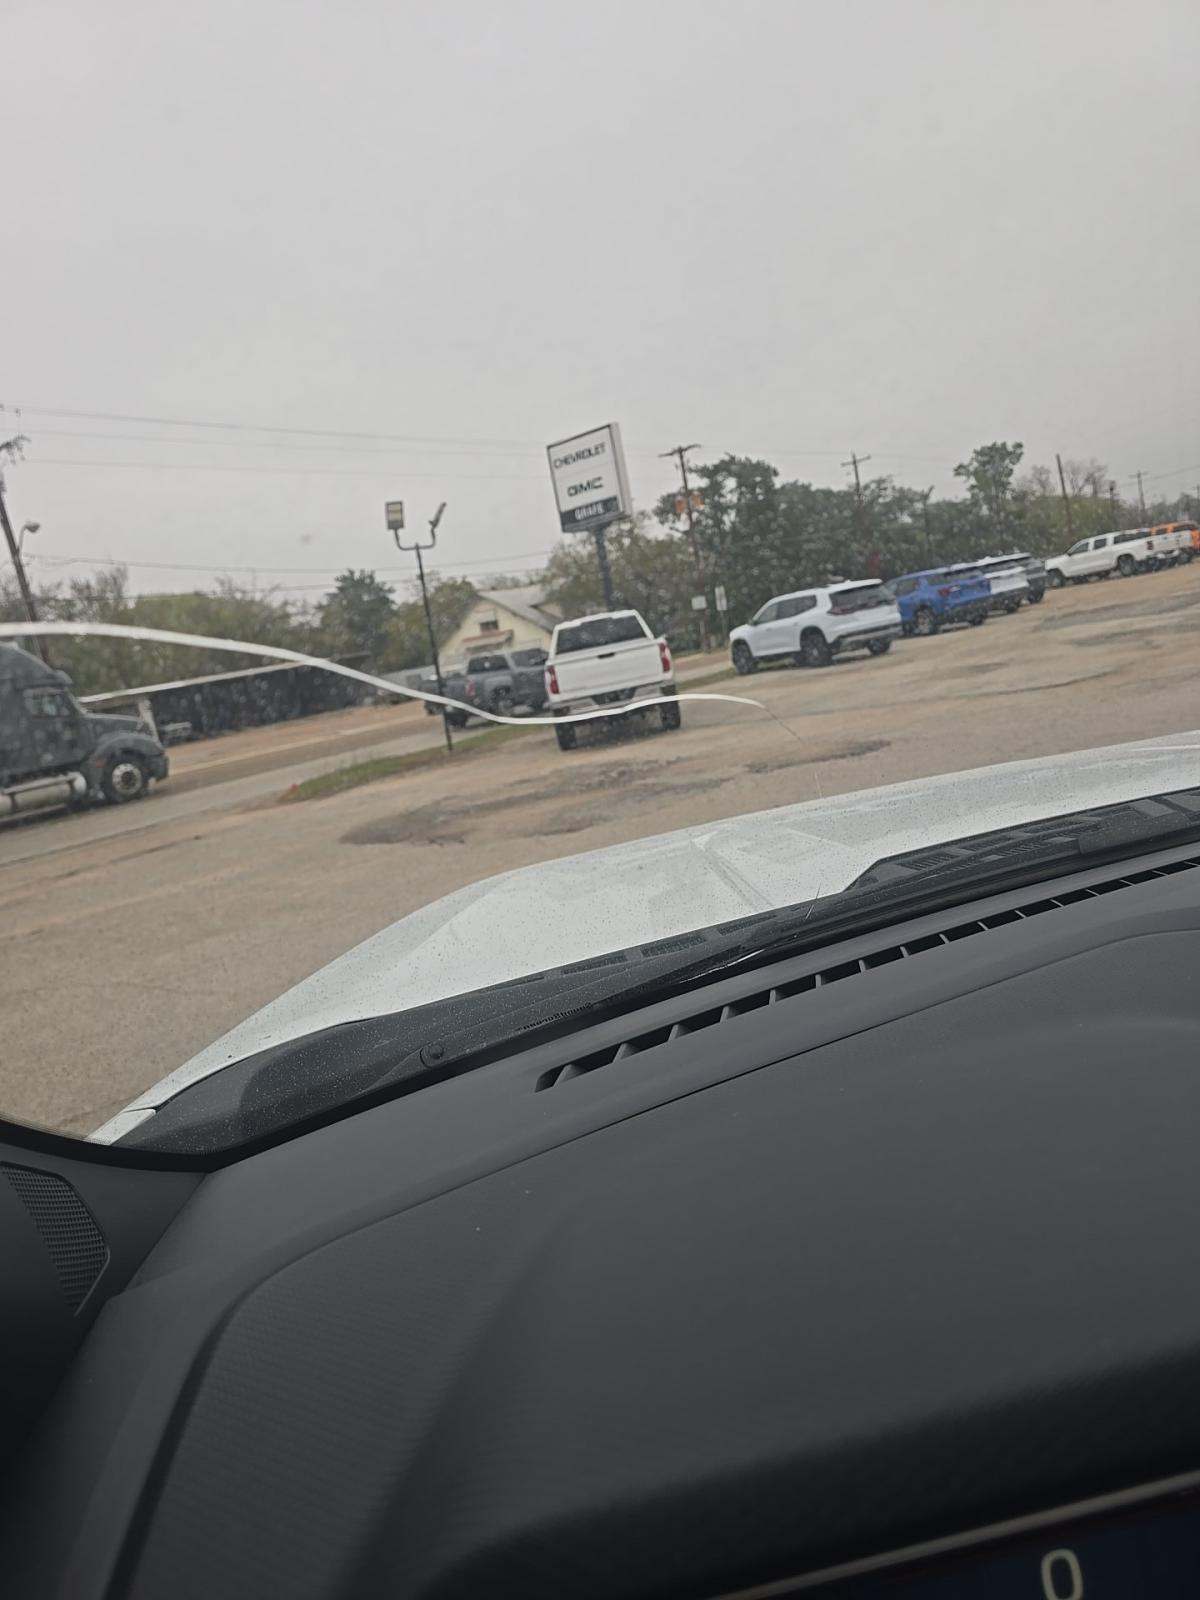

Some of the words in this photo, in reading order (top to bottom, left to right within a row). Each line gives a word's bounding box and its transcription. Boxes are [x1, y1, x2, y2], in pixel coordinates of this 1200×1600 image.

[553, 442, 606, 469] CHEVROLET
[567, 477, 604, 497] GMC
[1041, 1549, 1084, 1600] 0
